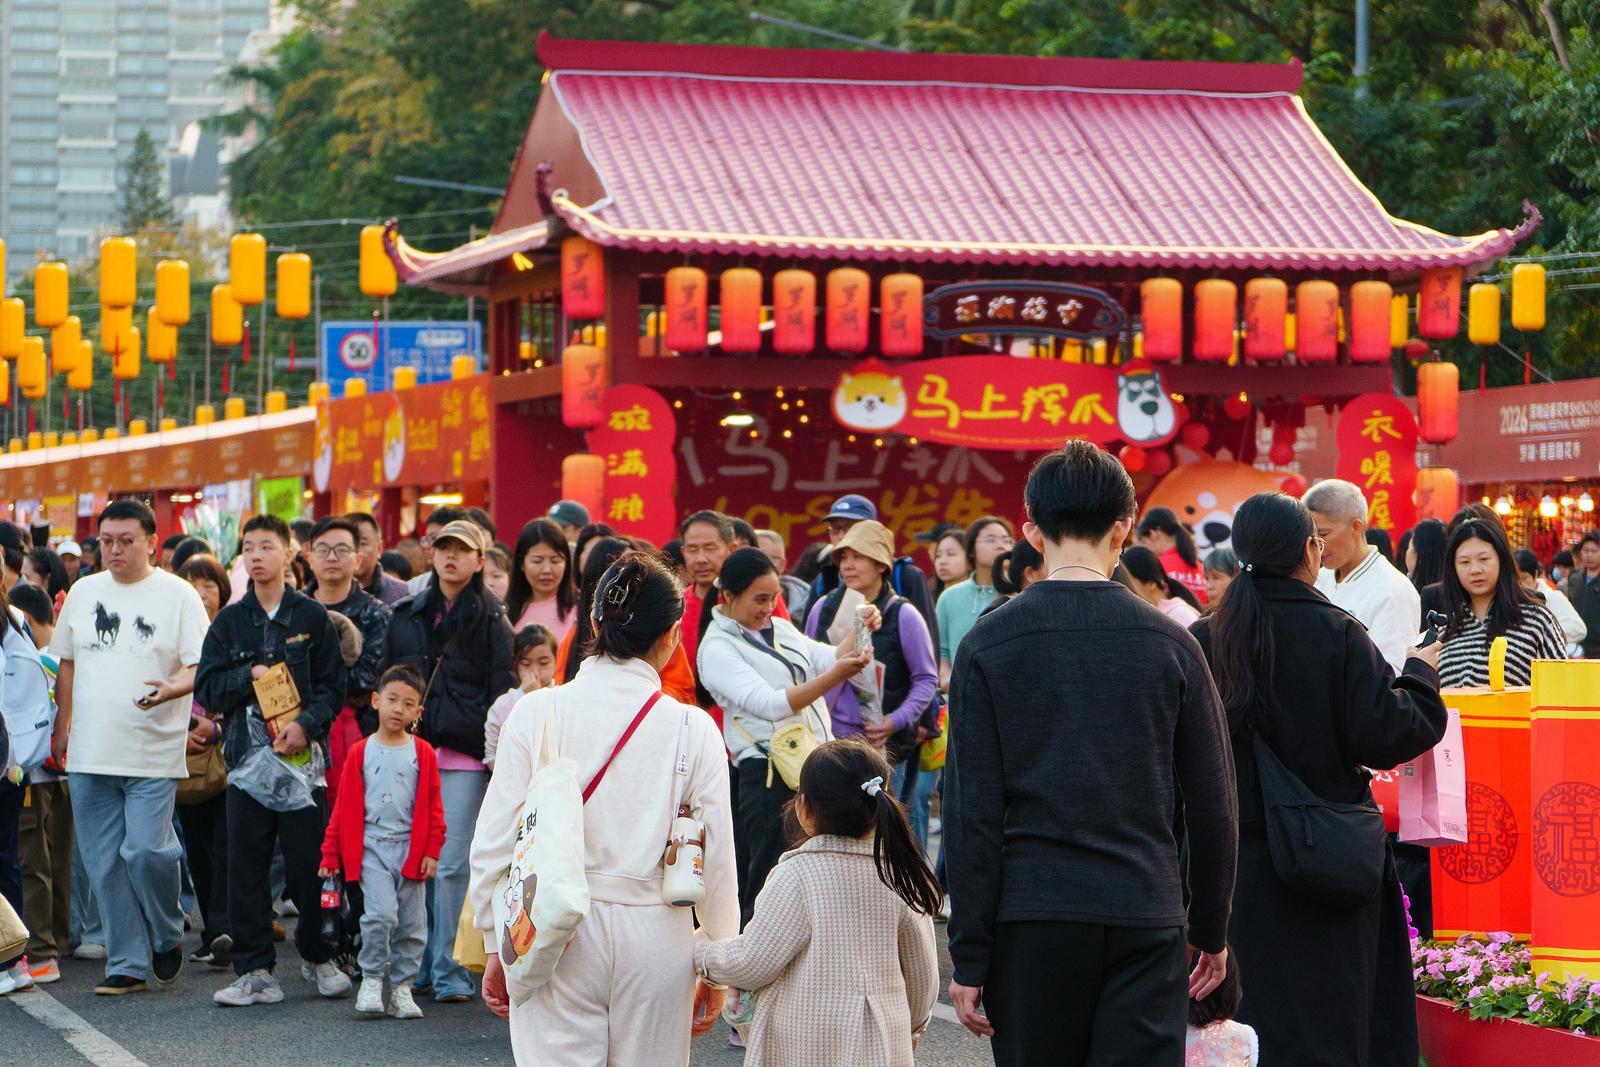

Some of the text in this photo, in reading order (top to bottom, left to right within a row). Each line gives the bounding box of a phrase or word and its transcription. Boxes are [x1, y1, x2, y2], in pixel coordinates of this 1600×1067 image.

[349, 342, 369, 359] 50
[912, 373, 1115, 430] 马上挥爪
[1500, 405, 1527, 434] 2026
